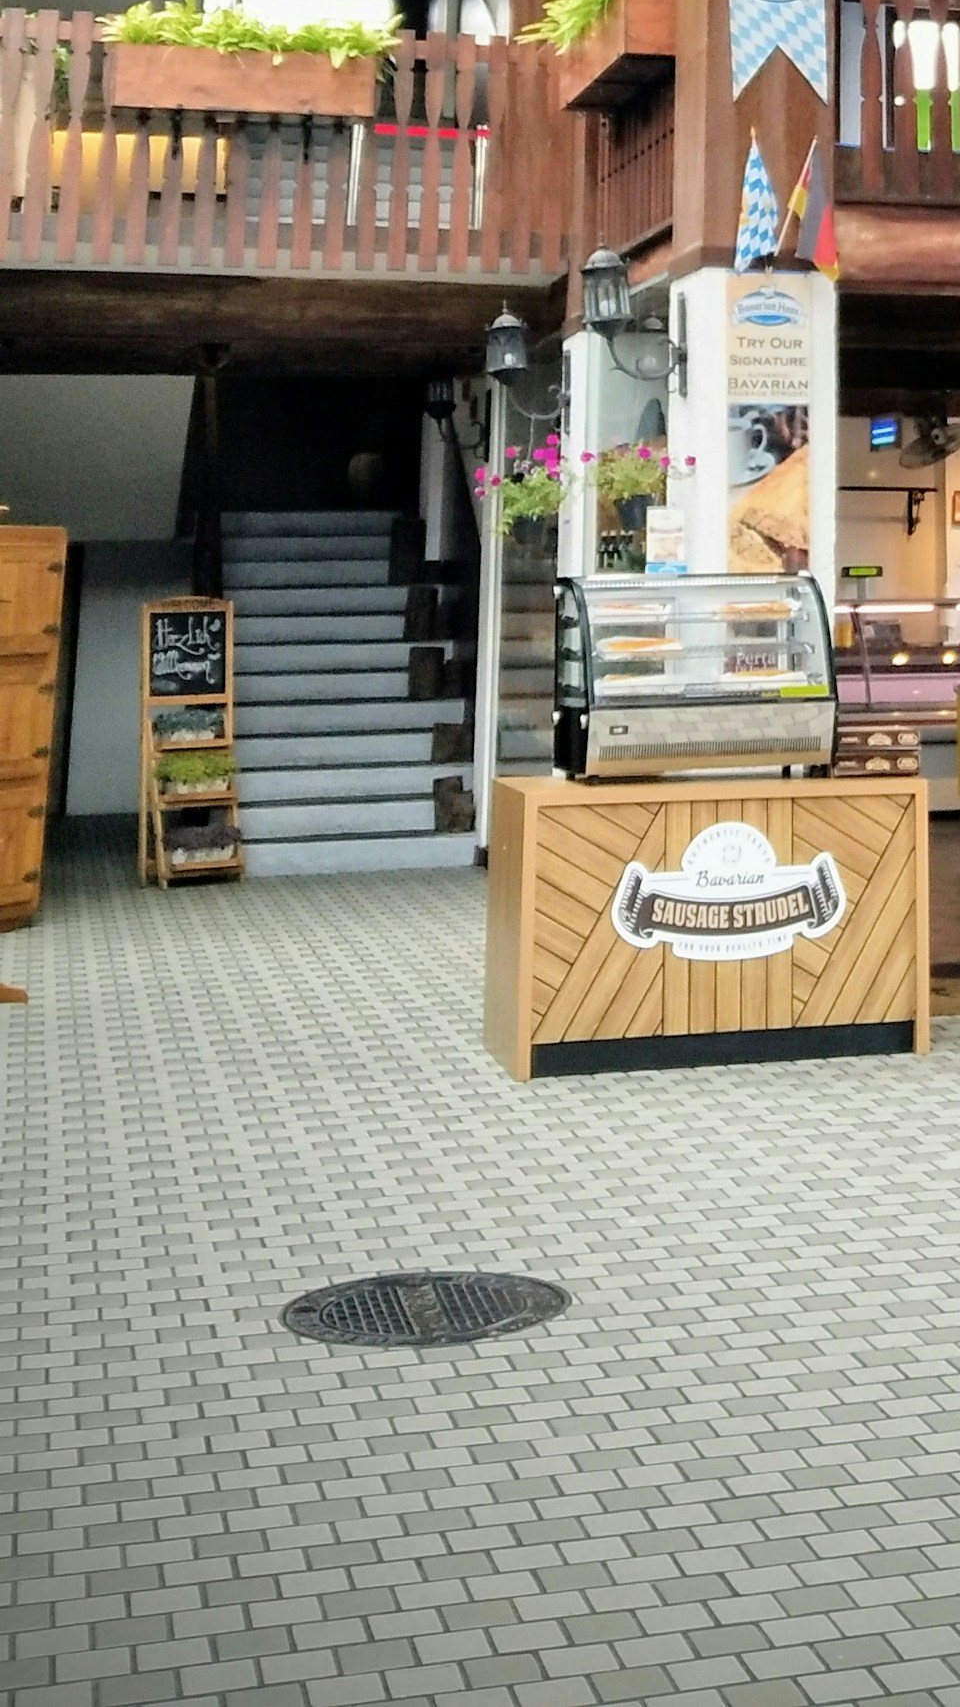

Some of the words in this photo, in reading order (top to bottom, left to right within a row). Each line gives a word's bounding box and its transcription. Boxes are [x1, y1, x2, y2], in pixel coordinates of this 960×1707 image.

[736, 336, 765, 348] TRY
[770, 337, 803, 349] OUR
[729, 355, 807, 367] SIGNATURE
[728, 377, 808, 390] BAVARIAN
[695, 870, 765, 888] Bavarian
[651, 898, 729, 929] SAUSAGE
[732, 892, 810, 929] STRUDEL
